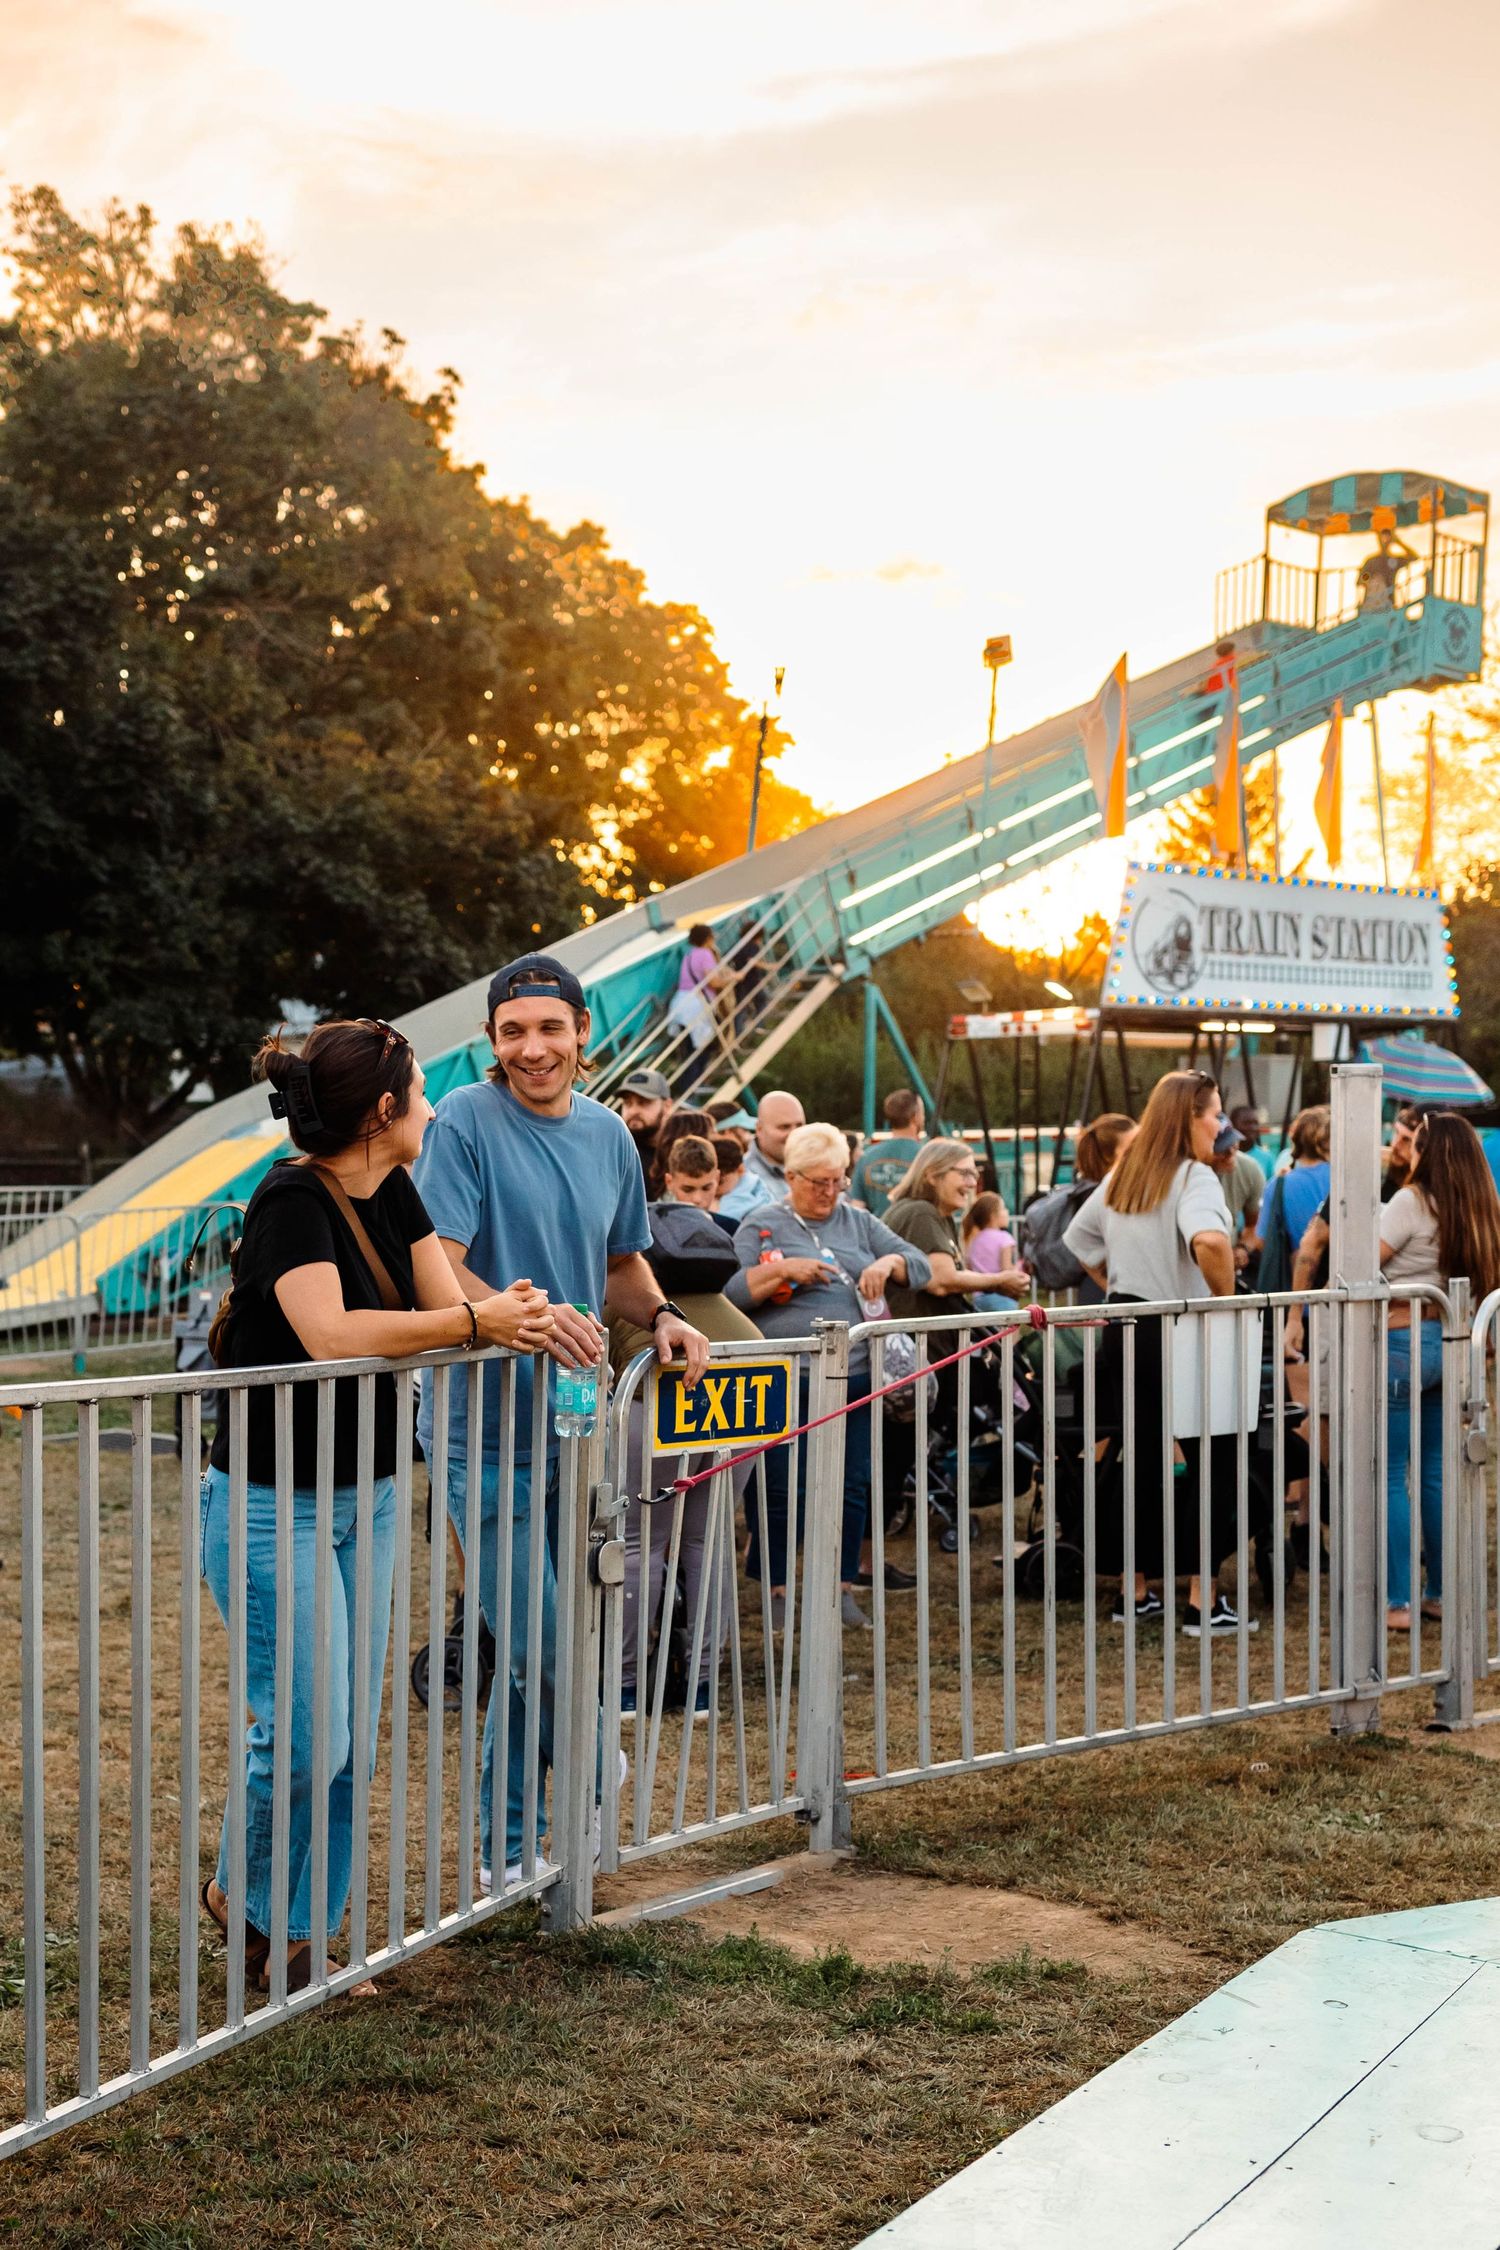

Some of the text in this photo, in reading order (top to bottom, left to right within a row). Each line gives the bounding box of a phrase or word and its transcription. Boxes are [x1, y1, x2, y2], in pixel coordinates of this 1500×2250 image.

[1199, 905, 1430, 967] TRAIN STATION
[674, 1374, 773, 1434] EXIT
